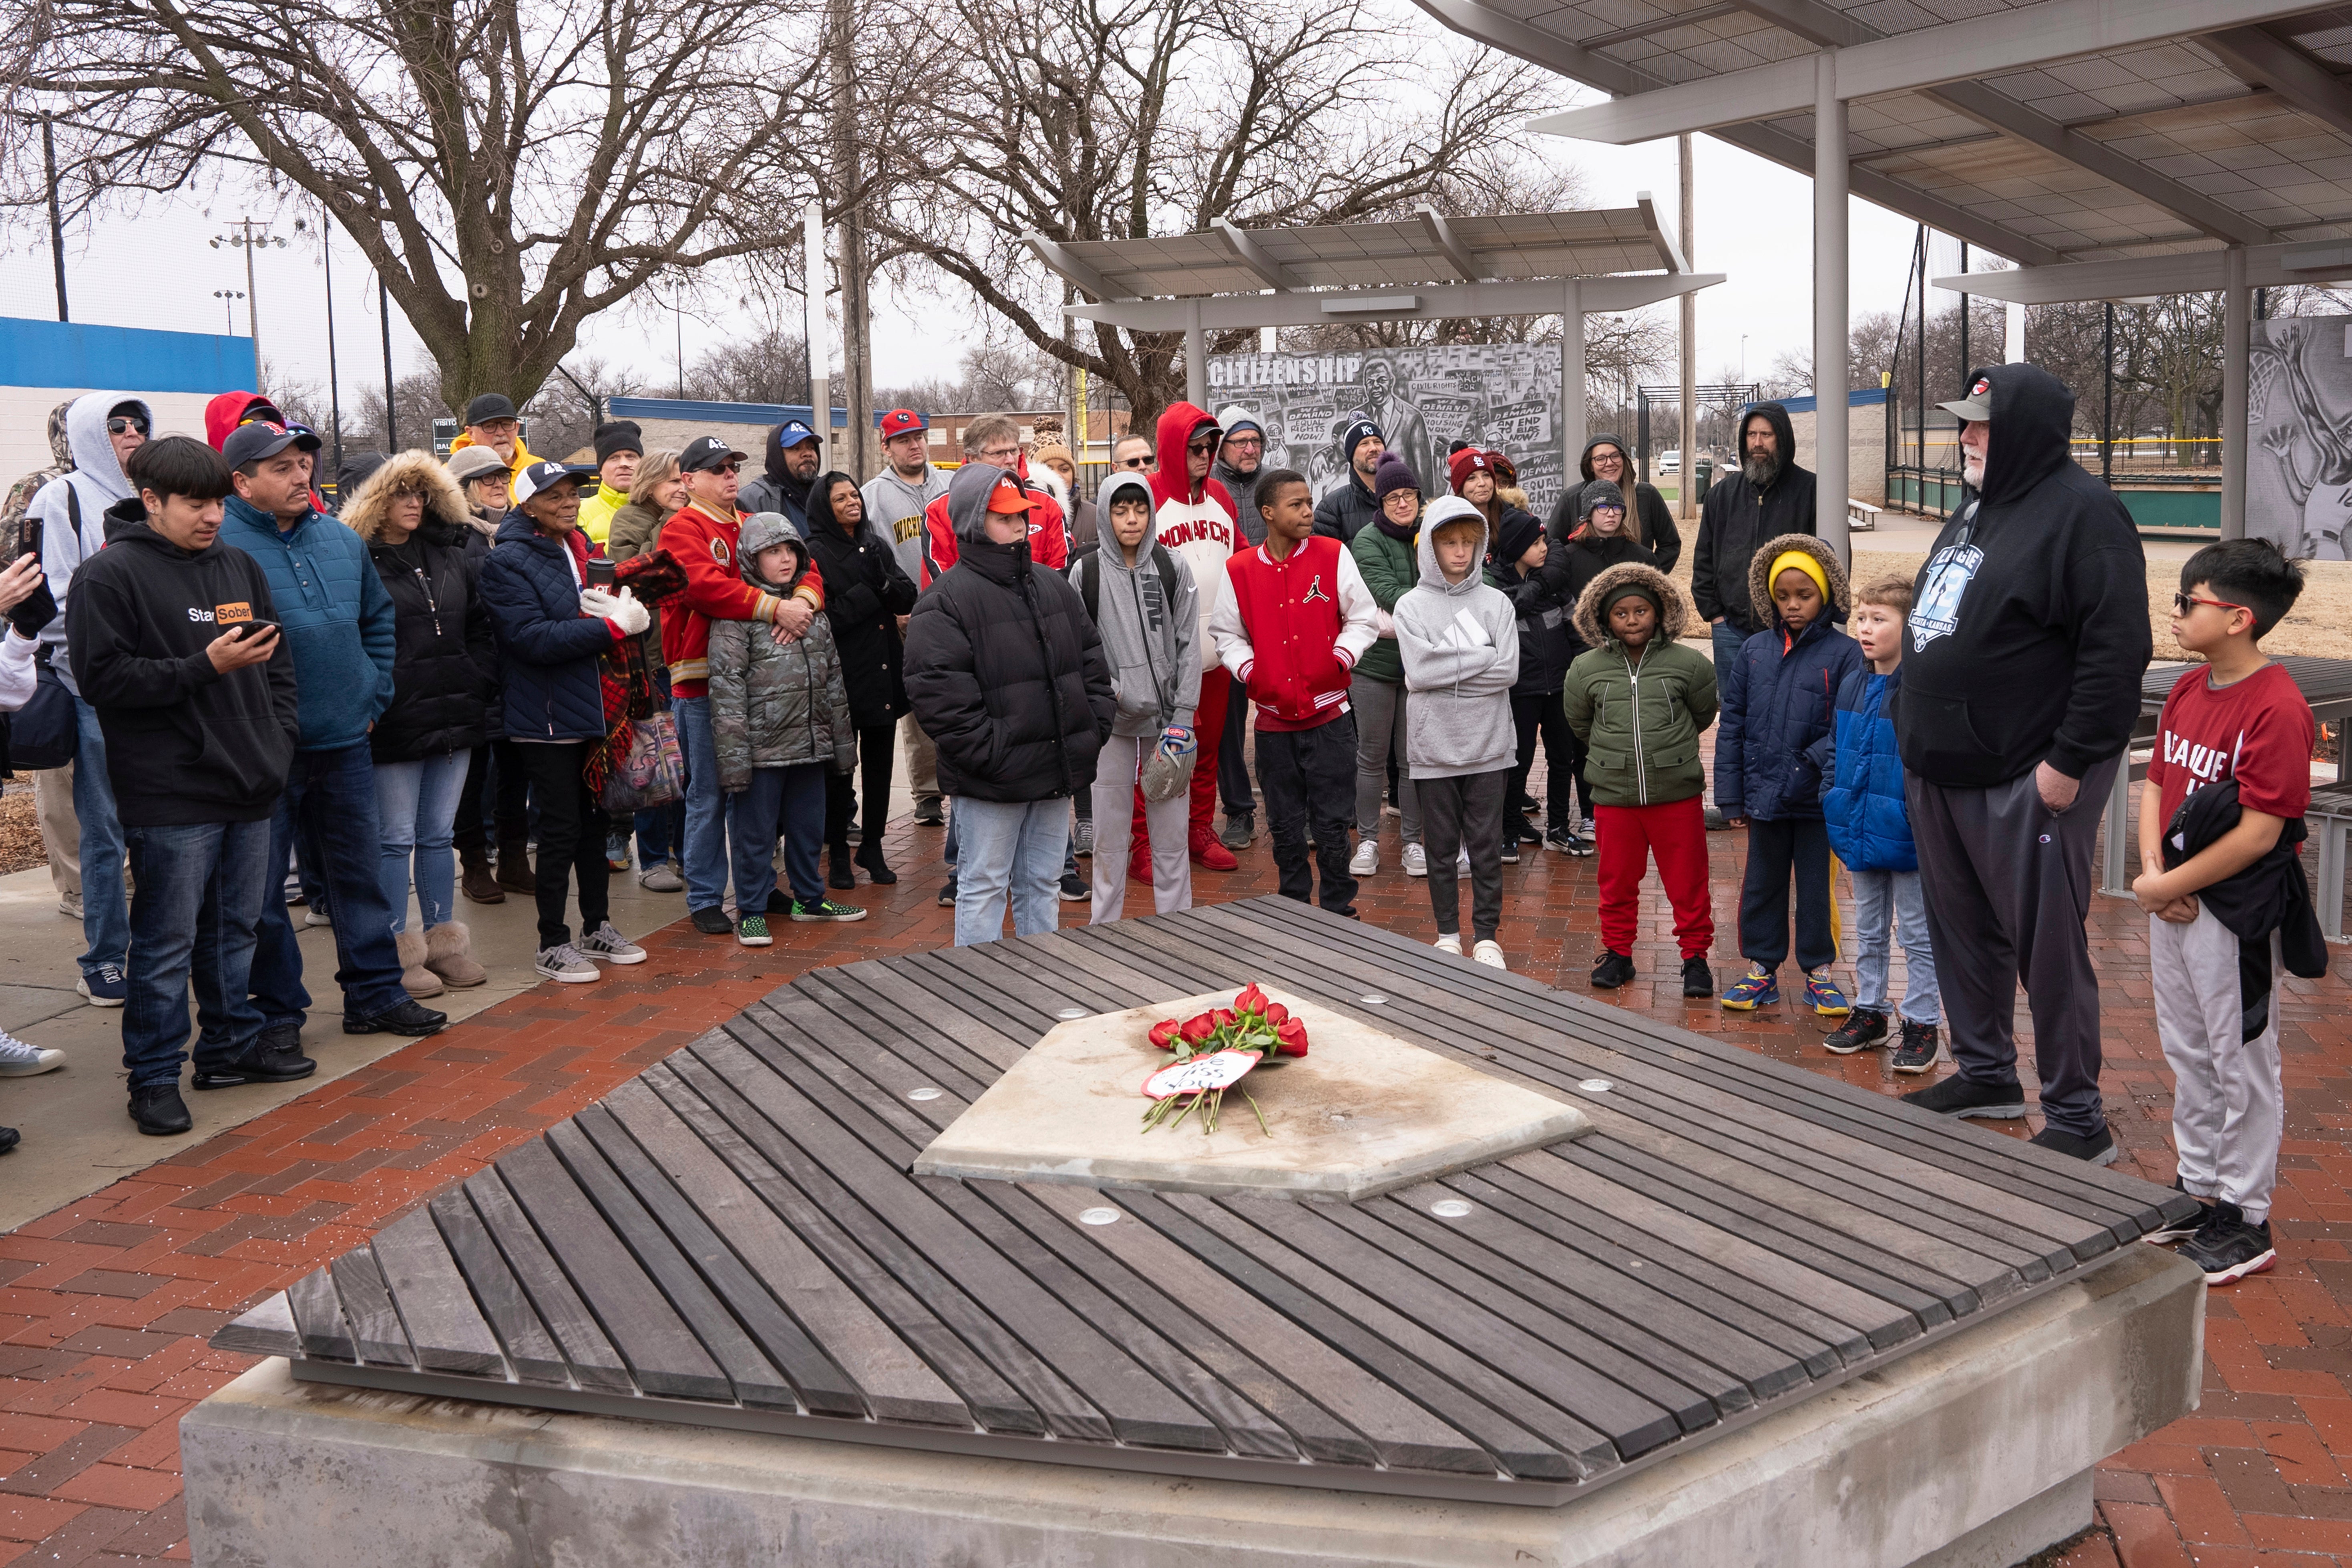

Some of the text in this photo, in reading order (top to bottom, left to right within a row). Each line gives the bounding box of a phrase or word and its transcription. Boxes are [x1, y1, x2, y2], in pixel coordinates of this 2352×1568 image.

[1210, 358, 1359, 386] CITIZENSHIP
[1422, 404, 1469, 412] DEMAND
[1494, 406, 1542, 420] DEMAND
[1289, 411, 1333, 420] DEMAND
[790, 423, 806, 432] 42
[1518, 417, 1541, 427] END
[1361, 425, 1373, 436] KC
[1427, 426, 1455, 435] NOW!
[1294, 432, 1324, 441] NOW!
[1509, 432, 1540, 442] NOW!
[708, 438, 728, 449] 42
[1533, 454, 1550, 464] WE
[544, 462, 566, 475] 42
[1520, 462, 1562, 480] DEMAND
[1522, 477, 1562, 491] EQUAL
[893, 515, 923, 545] WICHI
[1158, 520, 1230, 550] MONARCHS
[218, 606, 250, 620] Sober
[1928, 619, 1953, 632] KANSAS
